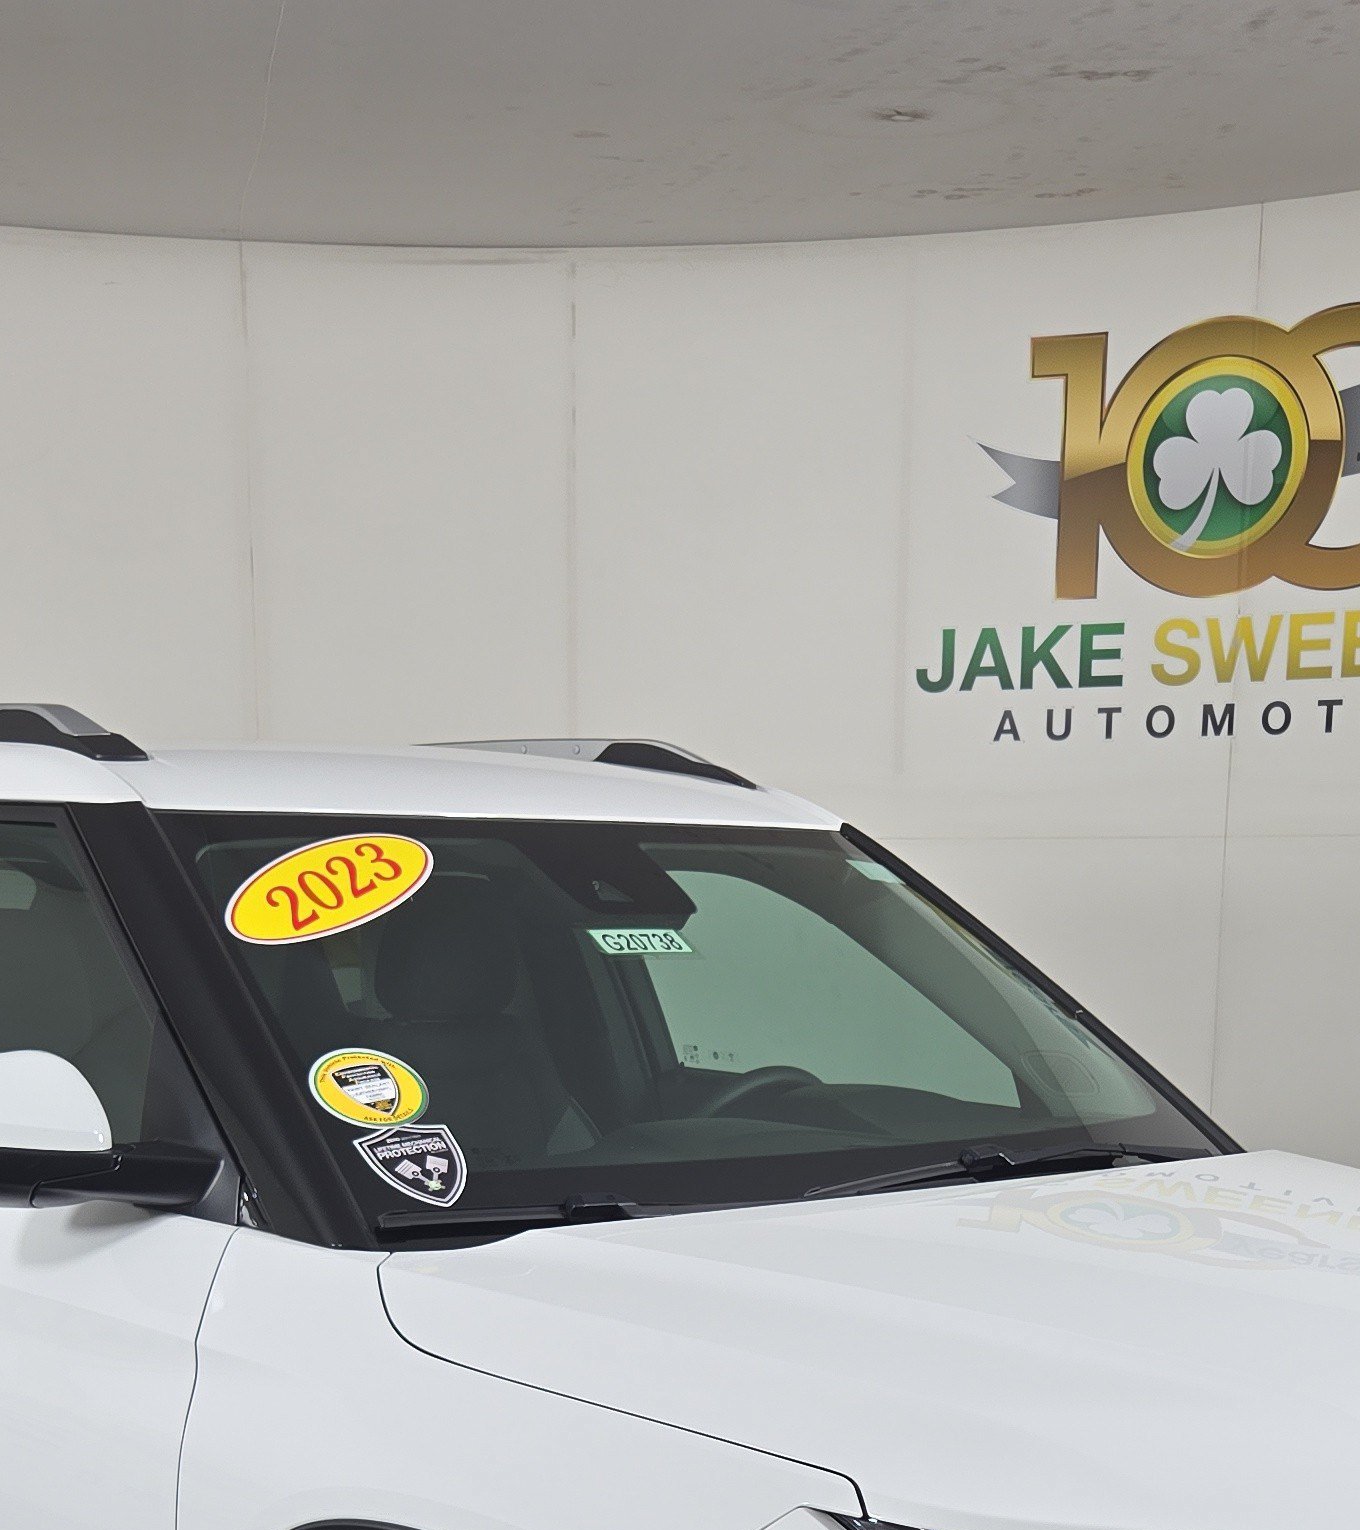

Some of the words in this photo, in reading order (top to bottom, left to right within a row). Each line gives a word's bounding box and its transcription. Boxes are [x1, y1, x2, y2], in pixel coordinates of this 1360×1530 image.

[915, 621, 1126, 693] JAKE
[265, 842, 403, 932] 2023
[601, 932, 683, 952] G20738
[376, 1140, 448, 1160] PROTECTION
